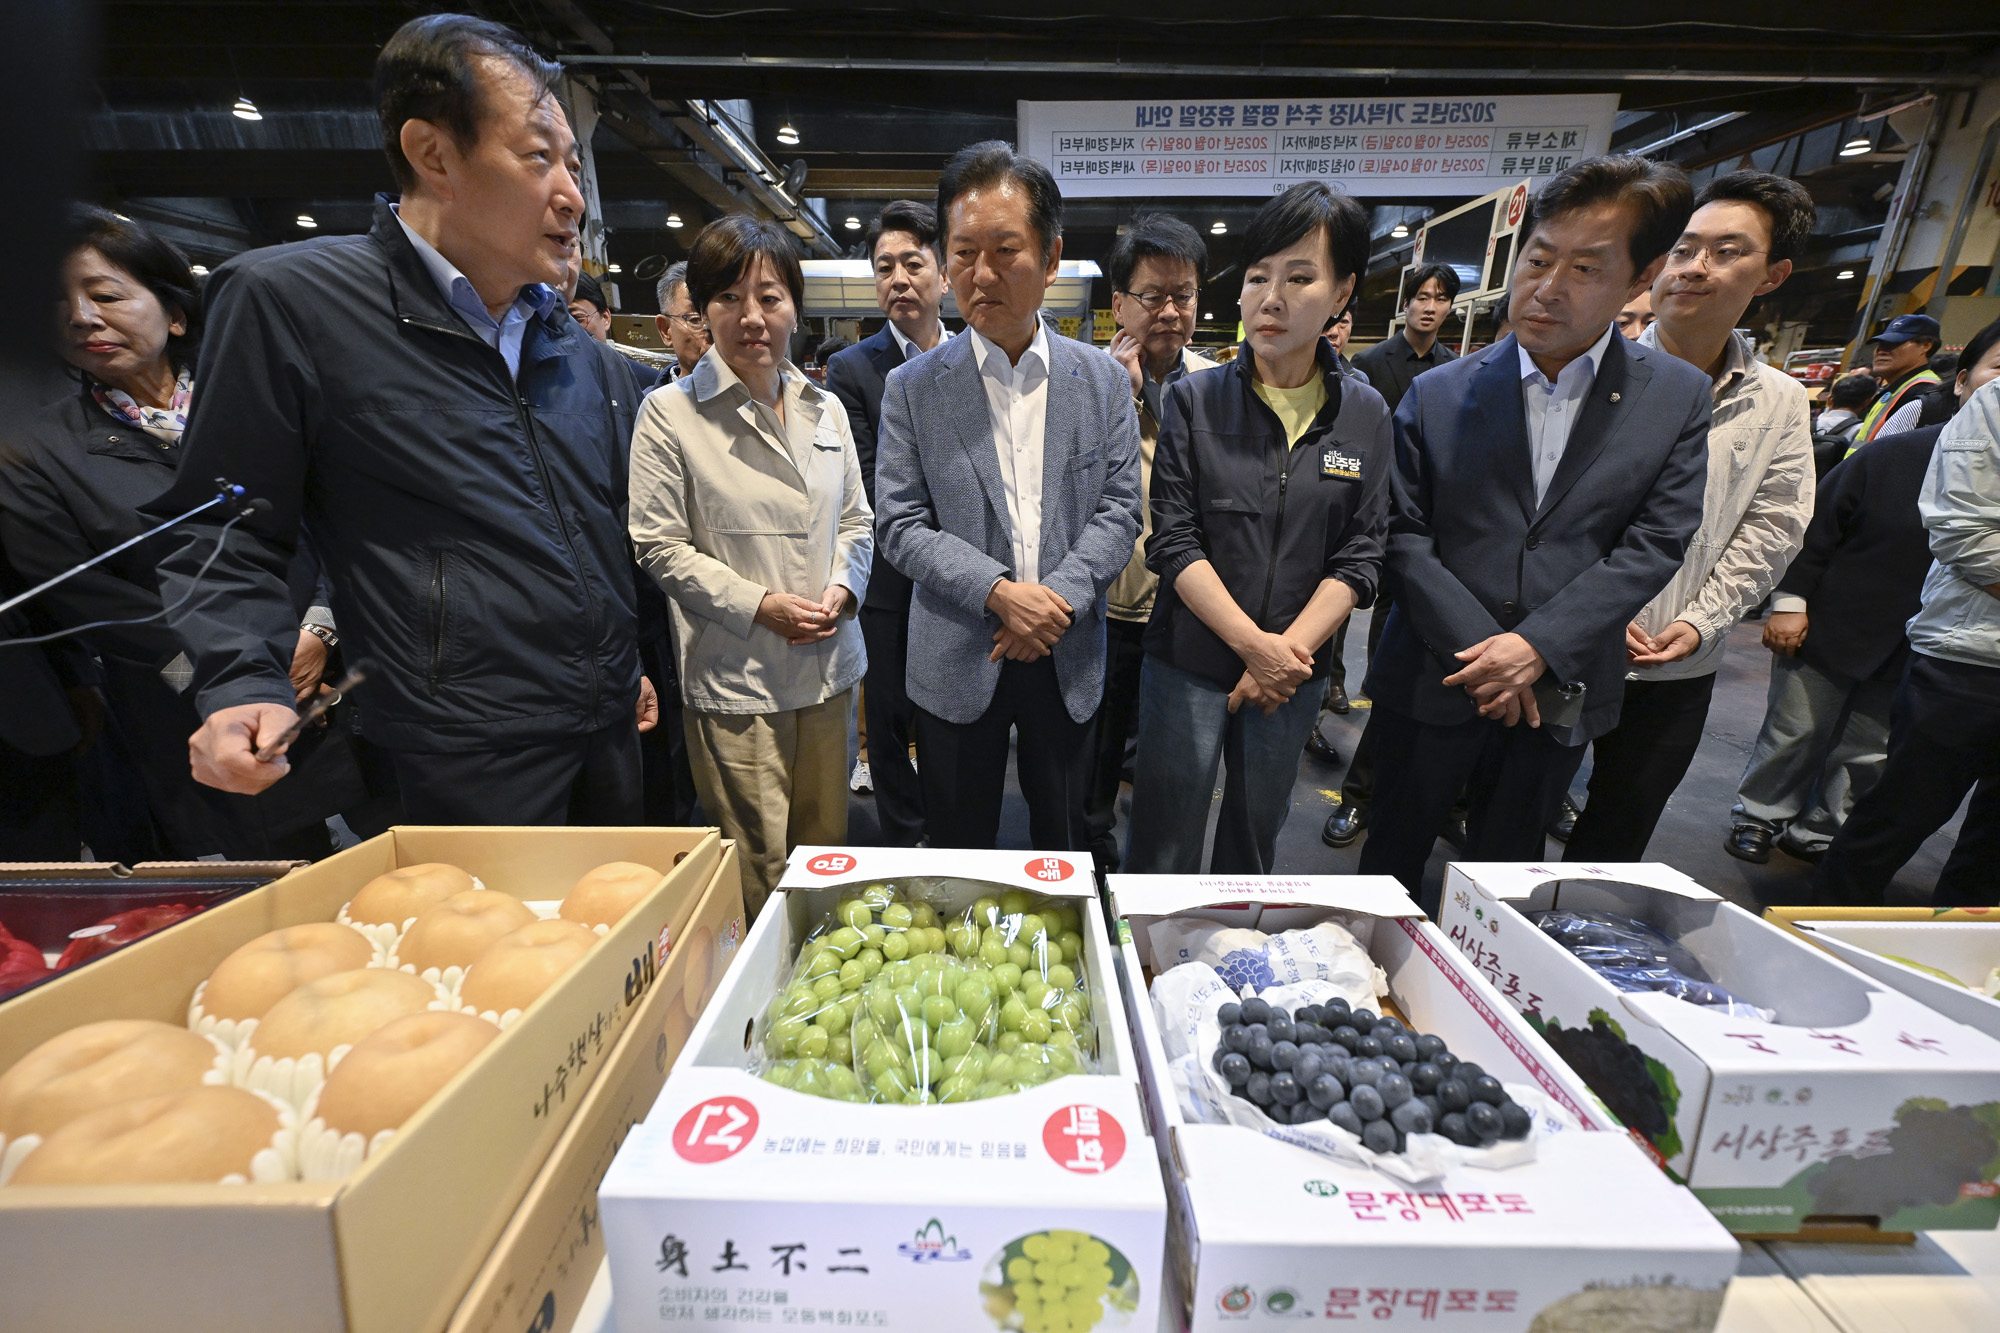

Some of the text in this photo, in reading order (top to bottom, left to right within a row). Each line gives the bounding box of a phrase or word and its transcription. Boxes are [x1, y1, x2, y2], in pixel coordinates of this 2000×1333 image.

[1510, 191, 1525, 219] 21
[1324, 454, 1361, 472] 민주당
[624, 940, 655, 1008] 배
[686, 1104, 750, 1152] 산
[1063, 1105, 1106, 1173] 백화
[763, 1137, 827, 1155] 농업에는
[894, 1138, 973, 1159] 국민에게는
[1345, 1191, 1535, 1223] 문장대포도
[655, 1232, 869, 1278] 身土不二
[657, 1286, 728, 1305] 소비자의
[1324, 1287, 1519, 1321] 문장대포도
